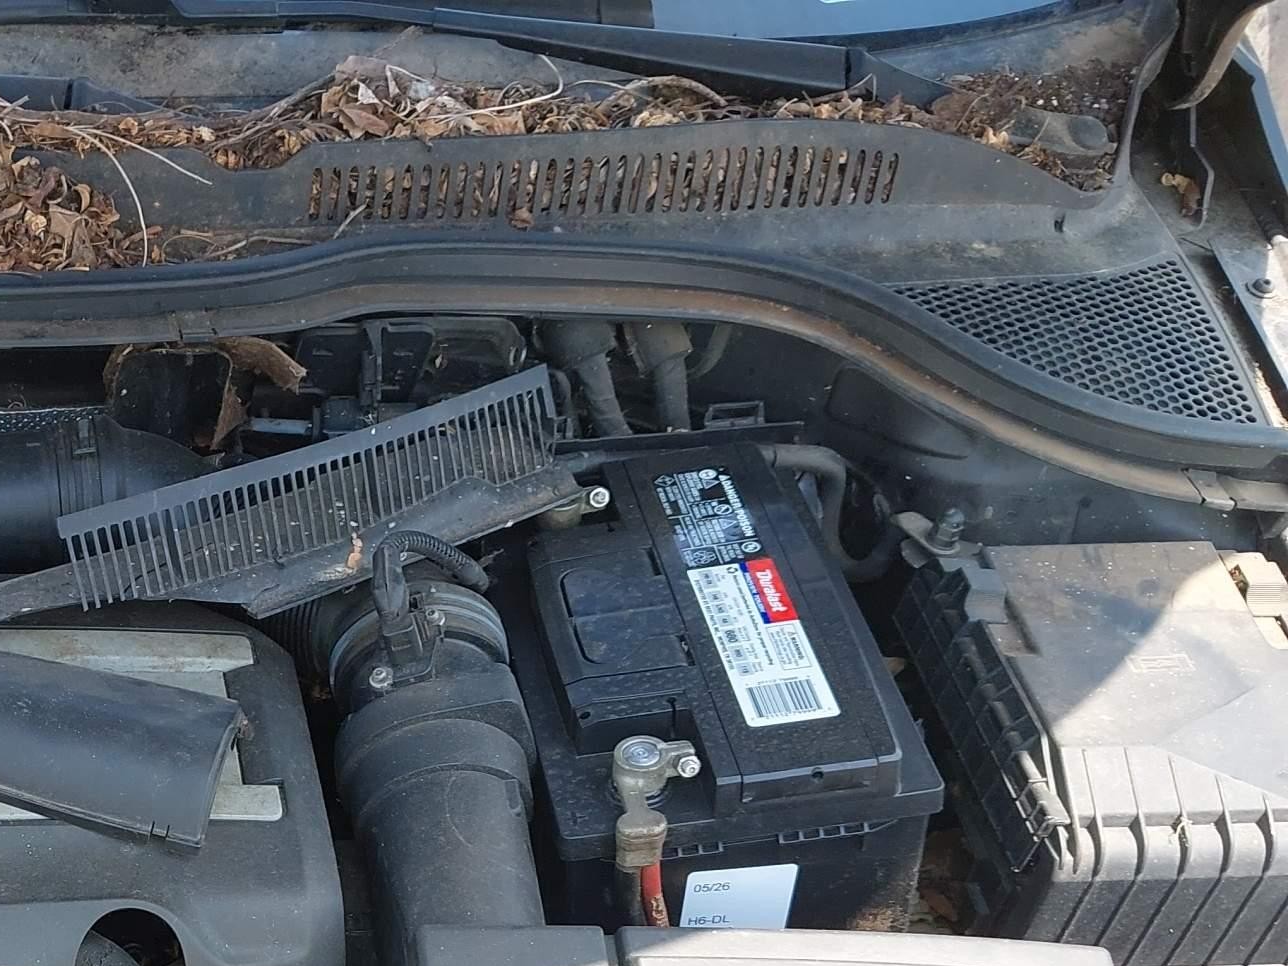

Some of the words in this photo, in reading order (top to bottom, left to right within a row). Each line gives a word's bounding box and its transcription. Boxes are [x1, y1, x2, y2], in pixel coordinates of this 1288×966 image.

[753, 568, 788, 612] Duralast
[723, 629, 738, 643] 680
[693, 882, 730, 892] 05/26
[688, 915, 730, 925] H6-DL
